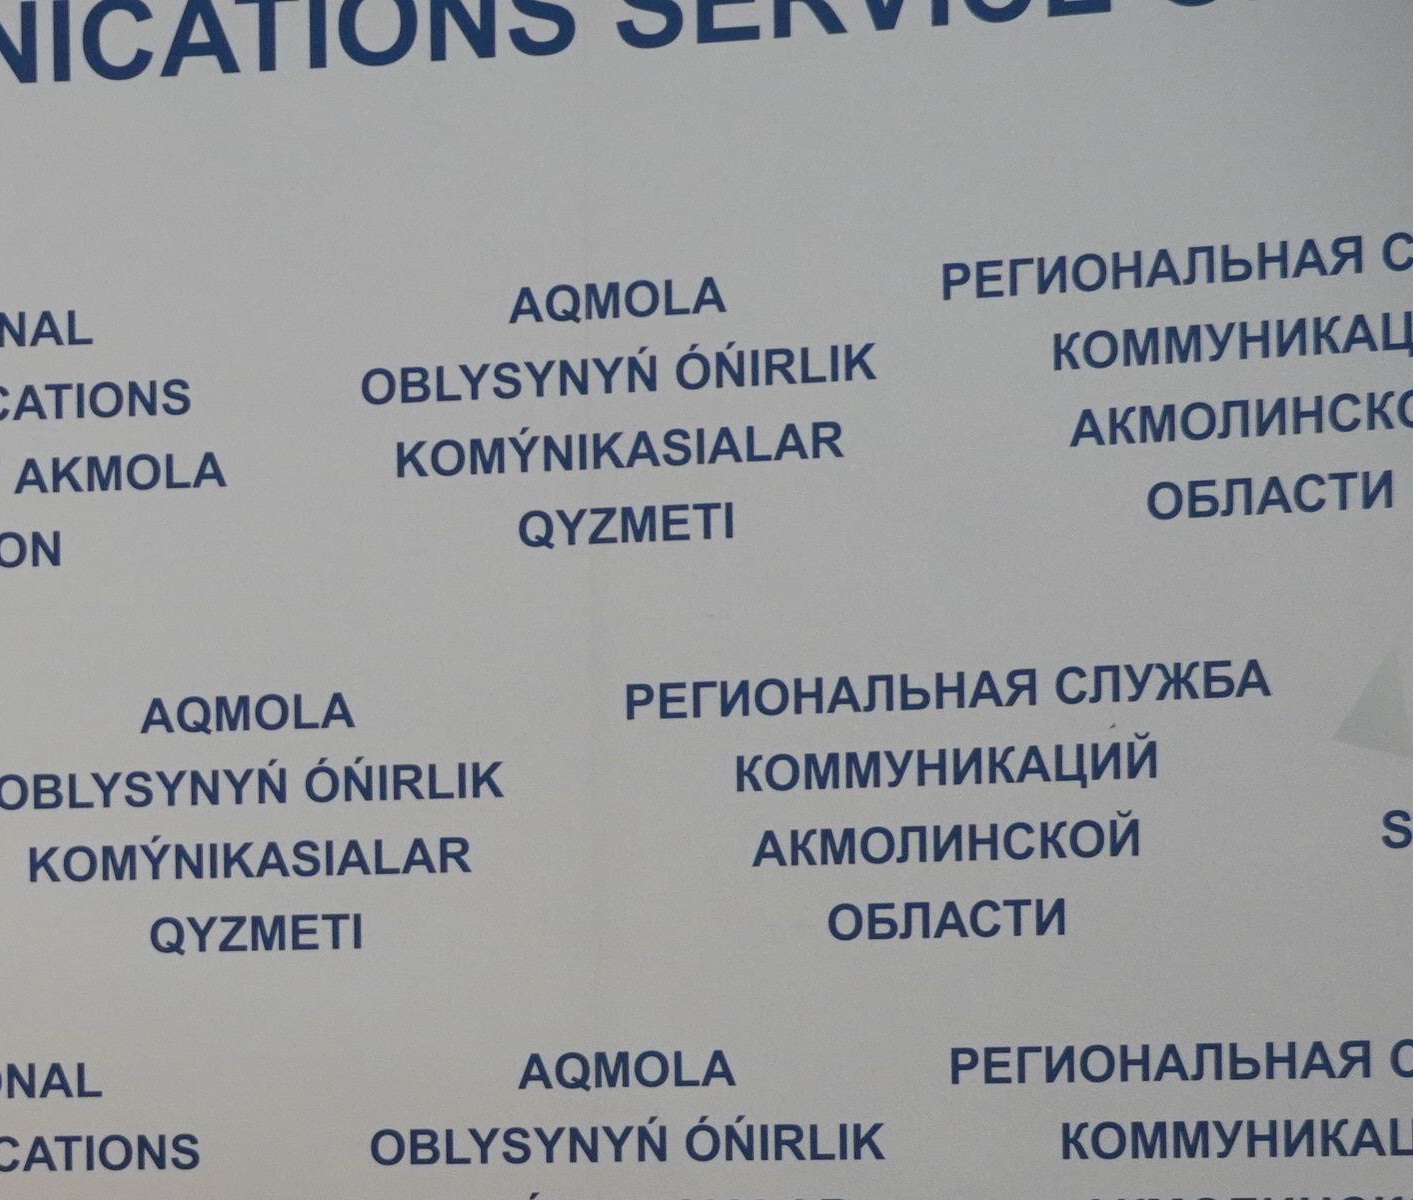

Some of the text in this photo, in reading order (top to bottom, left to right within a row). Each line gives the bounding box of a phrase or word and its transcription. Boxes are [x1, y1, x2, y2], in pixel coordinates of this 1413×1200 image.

[941, 234, 1364, 302] РЕГИОНАЛЬНАЯ
[508, 275, 728, 325] AQMOLA
[360, 337, 878, 407] OBLYSYNYŃ ÓŃIRLIK
[13, 450, 228, 495] AKMOLA
[395, 417, 845, 479] KOMÝNIKASIALAR
[1145, 468, 1394, 522] ОБЛАСТИ
[517, 500, 735, 551] QYZMETI
[139, 691, 357, 735] AQMOLA
[625, 657, 1272, 721] РЕГИОНАЛЬНАЯ СЛУЖБА
[303, 752, 505, 804] ÓŃIRLIK
[735, 728, 1158, 792] КОММУНИКАЦИЙ
[28, 832, 472, 883] KOMÝNIKASIALAR
[751, 806, 1141, 868] АКМОЛИНСКОЙ
[149, 912, 363, 956] QYZMETI
[826, 896, 1067, 942] ОБЛАСТИ
[518, 1048, 737, 1092] AQMOLA
[949, 1038, 1373, 1085] РЕГИОНАЛЬНАЯ
[369, 1111, 887, 1167] OBLYSYNYŃ ÓŃIRLIK
